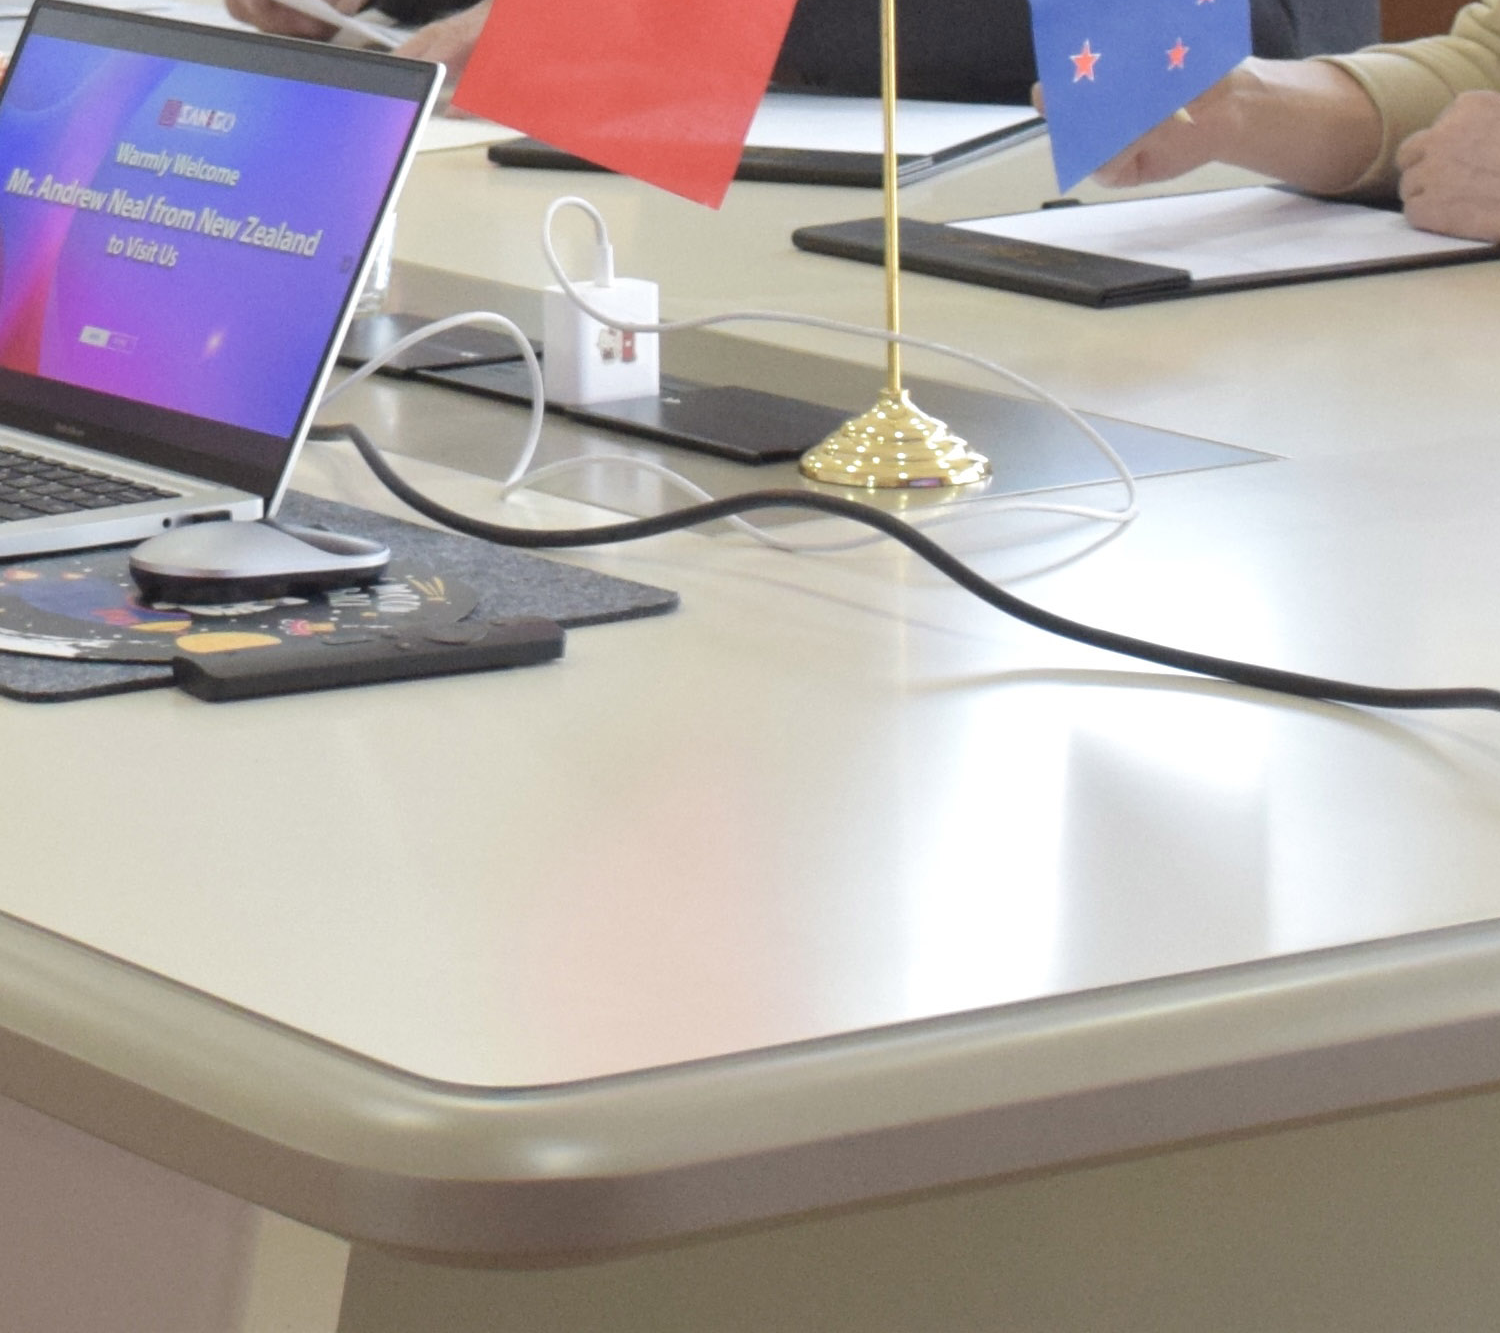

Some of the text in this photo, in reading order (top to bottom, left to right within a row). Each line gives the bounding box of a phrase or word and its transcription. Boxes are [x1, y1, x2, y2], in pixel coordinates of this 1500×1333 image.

[116, 142, 240, 186] Warmly Welcome
[5, 167, 323, 257] Mr. Andrew Neal from New Zealand
[107, 234, 179, 267] to Visit Us
